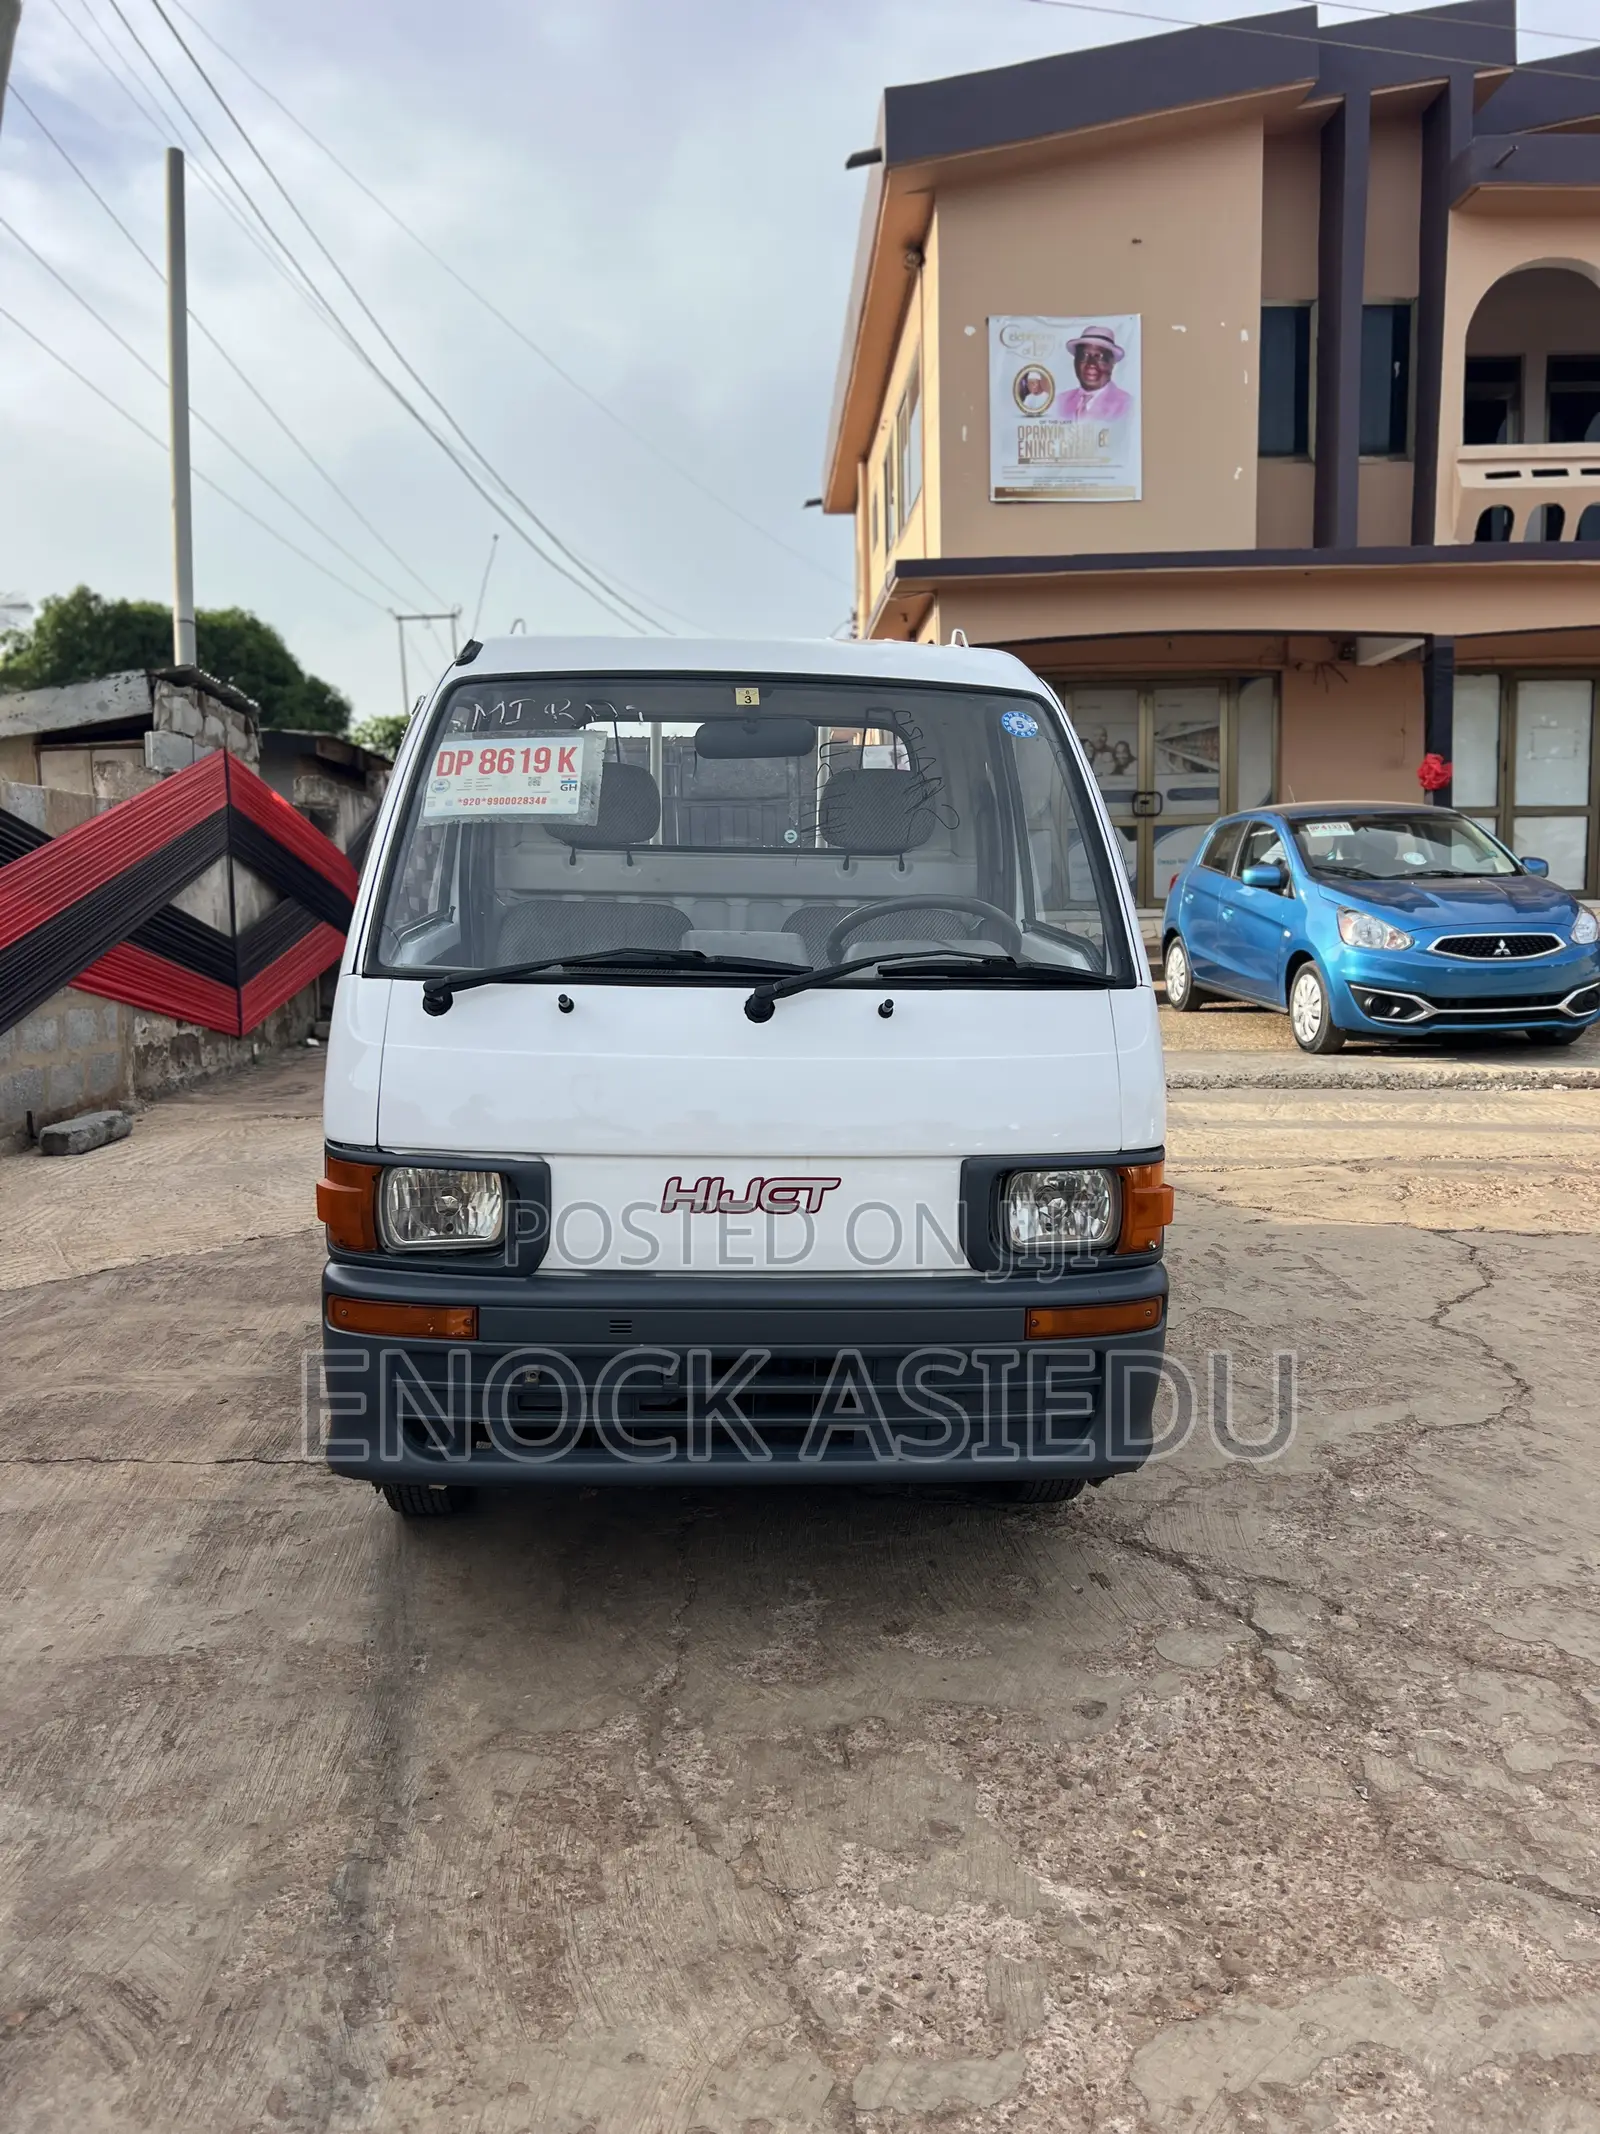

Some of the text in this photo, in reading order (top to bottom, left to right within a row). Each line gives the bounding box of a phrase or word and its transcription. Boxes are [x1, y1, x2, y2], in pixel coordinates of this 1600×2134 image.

[744, 695, 752, 704] 3
[1016, 720, 1025, 729] 5
[436, 747, 578, 776] DP 8619 K
[560, 784, 578, 792] GH
[660, 1176, 842, 1215] HIJET
